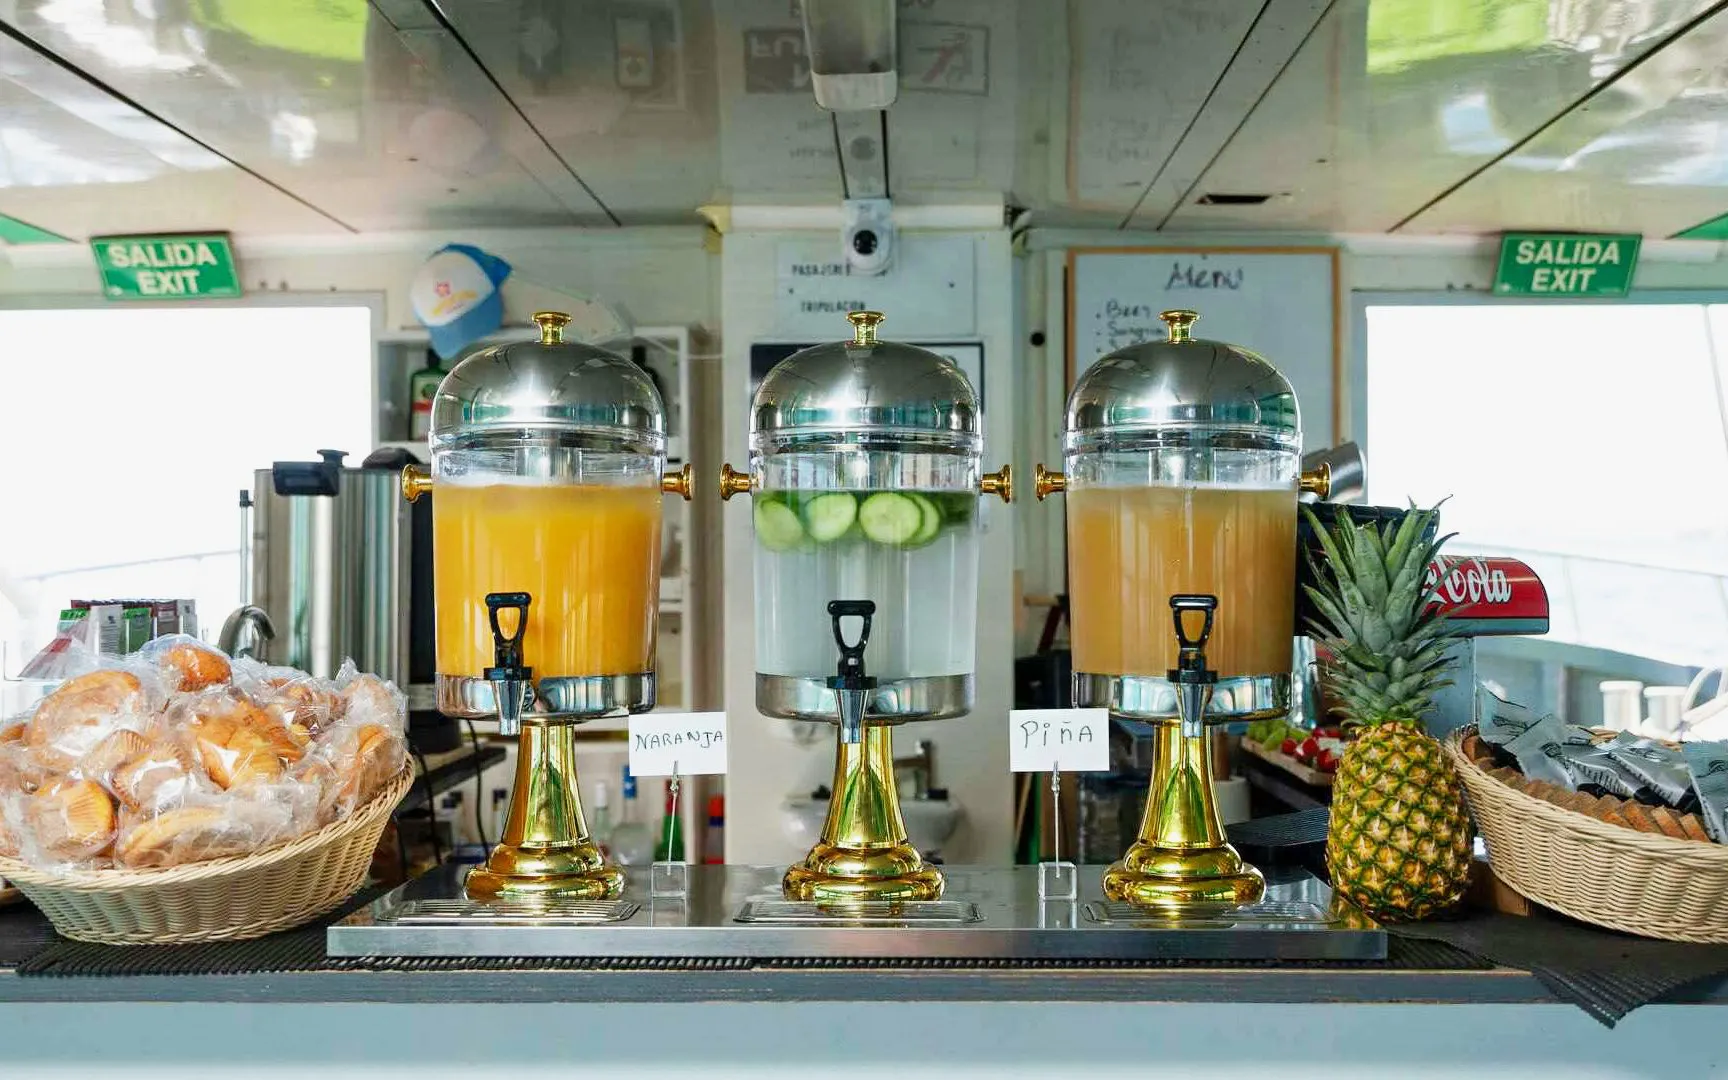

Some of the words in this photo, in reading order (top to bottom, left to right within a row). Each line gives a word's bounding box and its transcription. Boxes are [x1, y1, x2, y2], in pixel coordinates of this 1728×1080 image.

[108, 241, 218, 268] SALIDA
[1516, 240, 1621, 265] SALIDA
[137, 270, 200, 295] EXIT
[1531, 268, 1597, 292] EXIT
[635, 730, 723, 752] NARANJA
